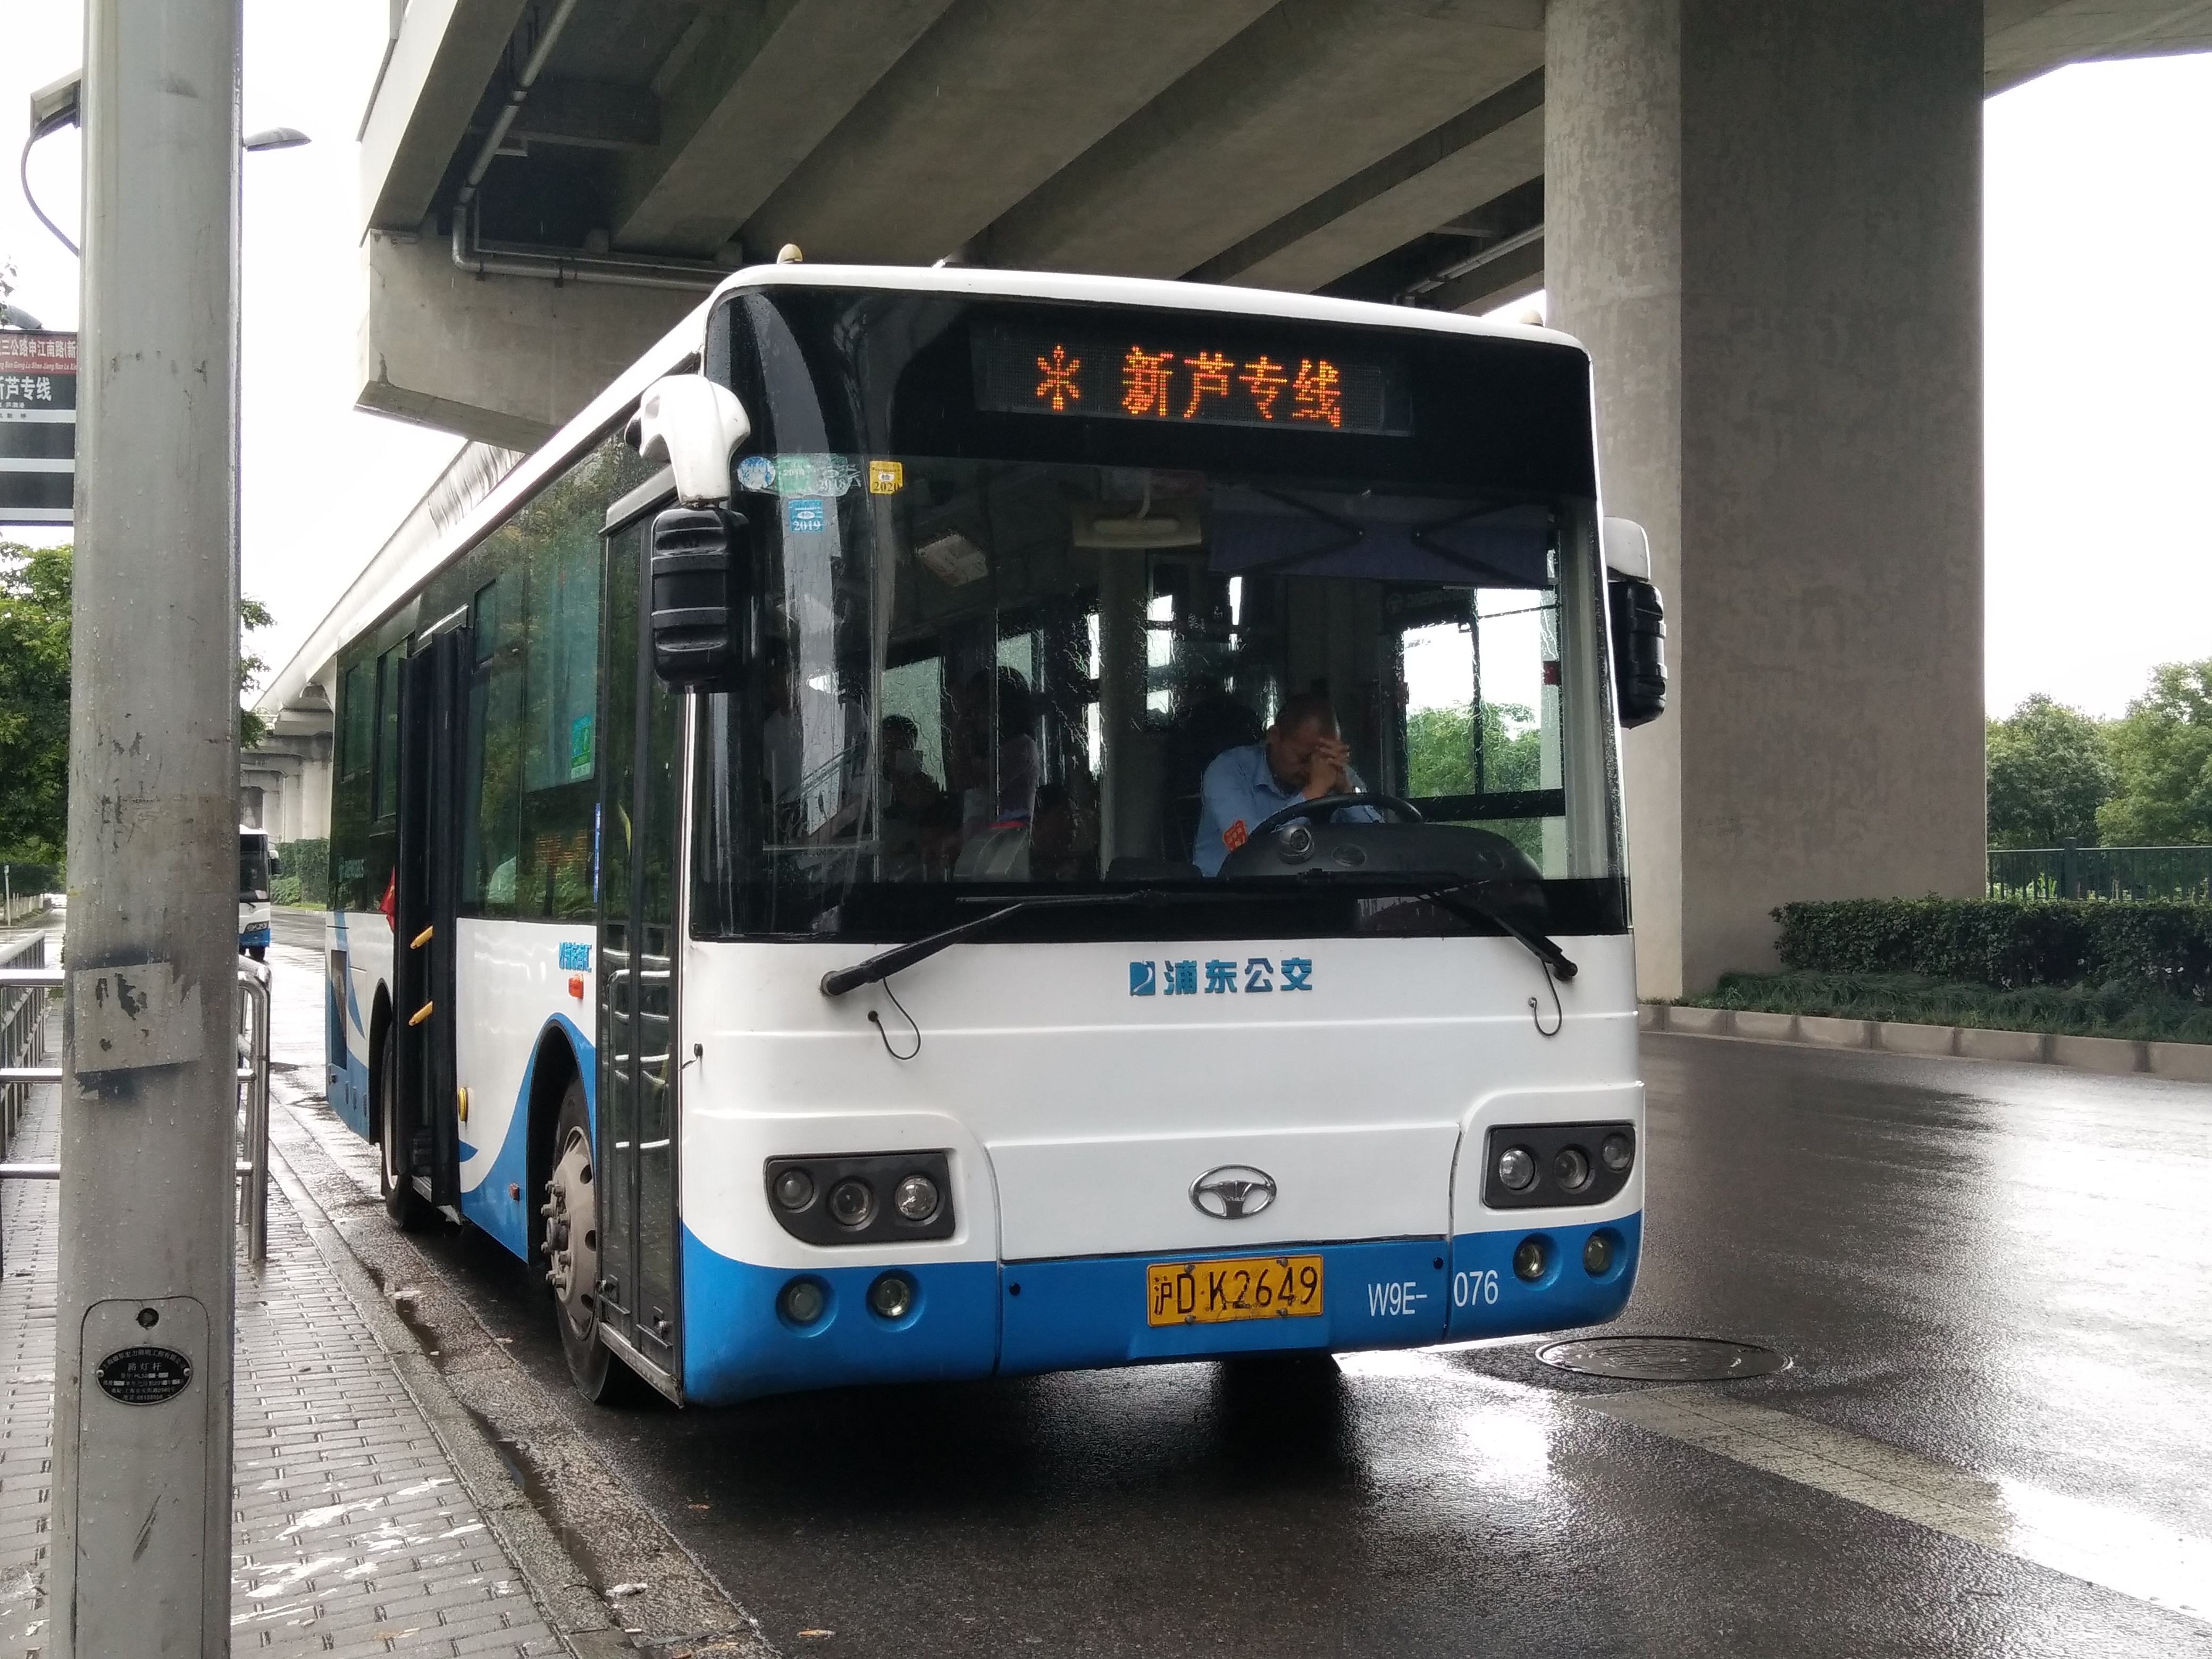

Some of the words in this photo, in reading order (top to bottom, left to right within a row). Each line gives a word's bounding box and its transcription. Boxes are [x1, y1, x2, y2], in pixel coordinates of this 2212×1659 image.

[0, 338, 76, 358] 三公路申江南路(新
[1122, 345, 1342, 429] 新芦专线
[873, 482, 900, 492] 2020
[793, 520, 821, 531] 2019
[1163, 957, 1313, 995] 浦东公交
